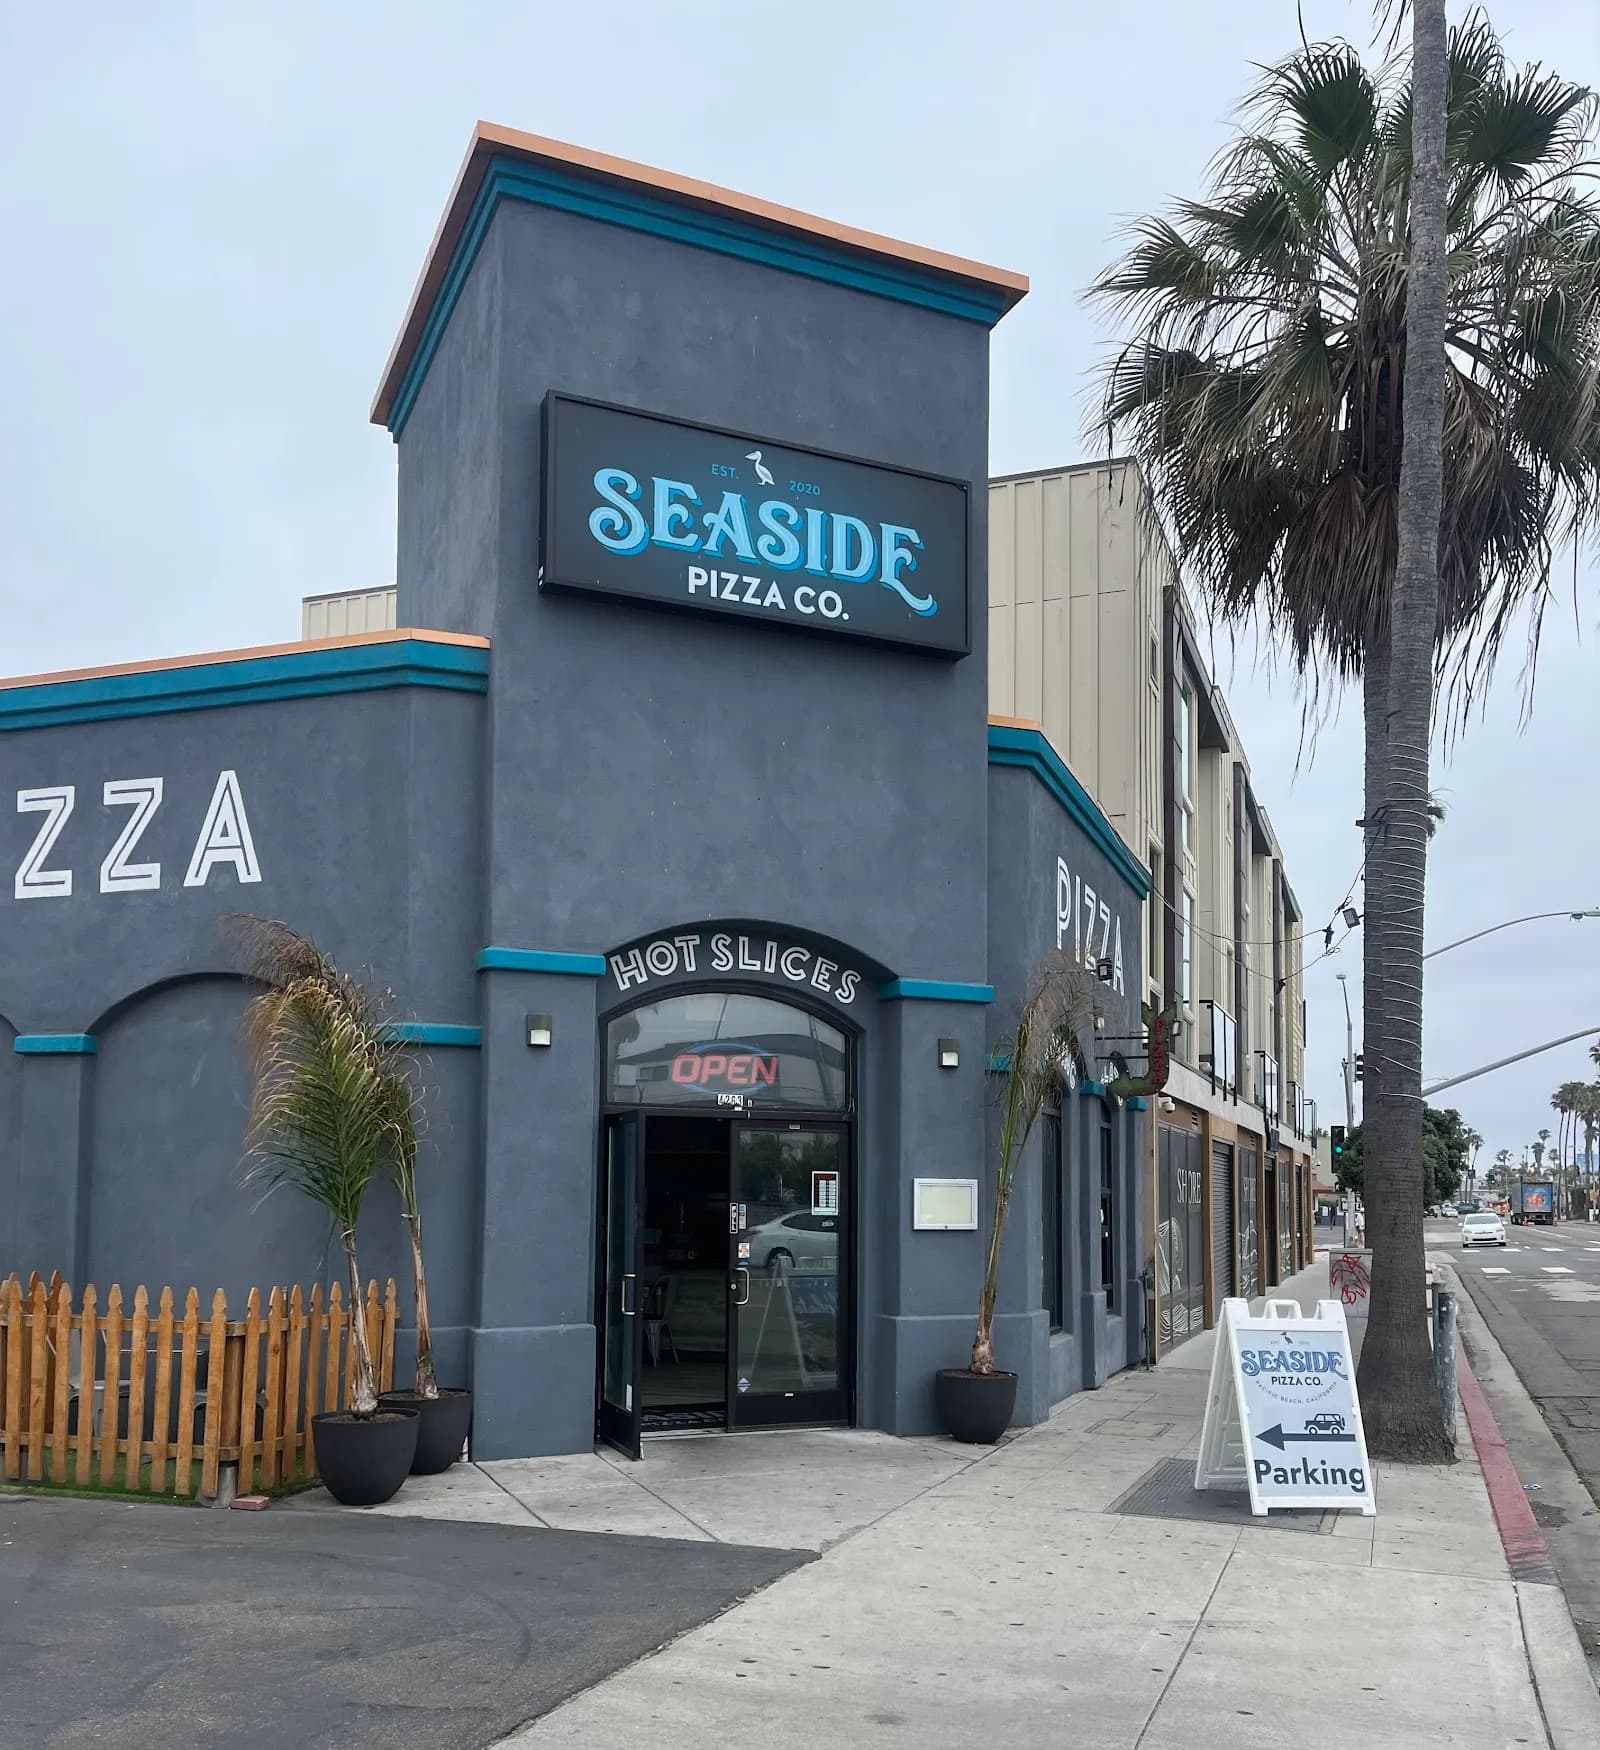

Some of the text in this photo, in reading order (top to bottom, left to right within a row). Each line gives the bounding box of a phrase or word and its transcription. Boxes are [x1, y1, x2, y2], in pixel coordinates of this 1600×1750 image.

[711, 463, 821, 497] EST. 2020
[588, 467, 938, 617] SEASIDE
[688, 565, 850, 621] PIZZA CO.
[15, 770, 262, 899] ZZA
[609, 933, 862, 1004] HOT SLICES
[671, 1053, 780, 1086] OPEN
[1240, 1350, 1349, 1381] SEASIDE
[1271, 1376, 1324, 1386] PIZZA CO.
[1254, 1457, 1366, 1493] Parking
